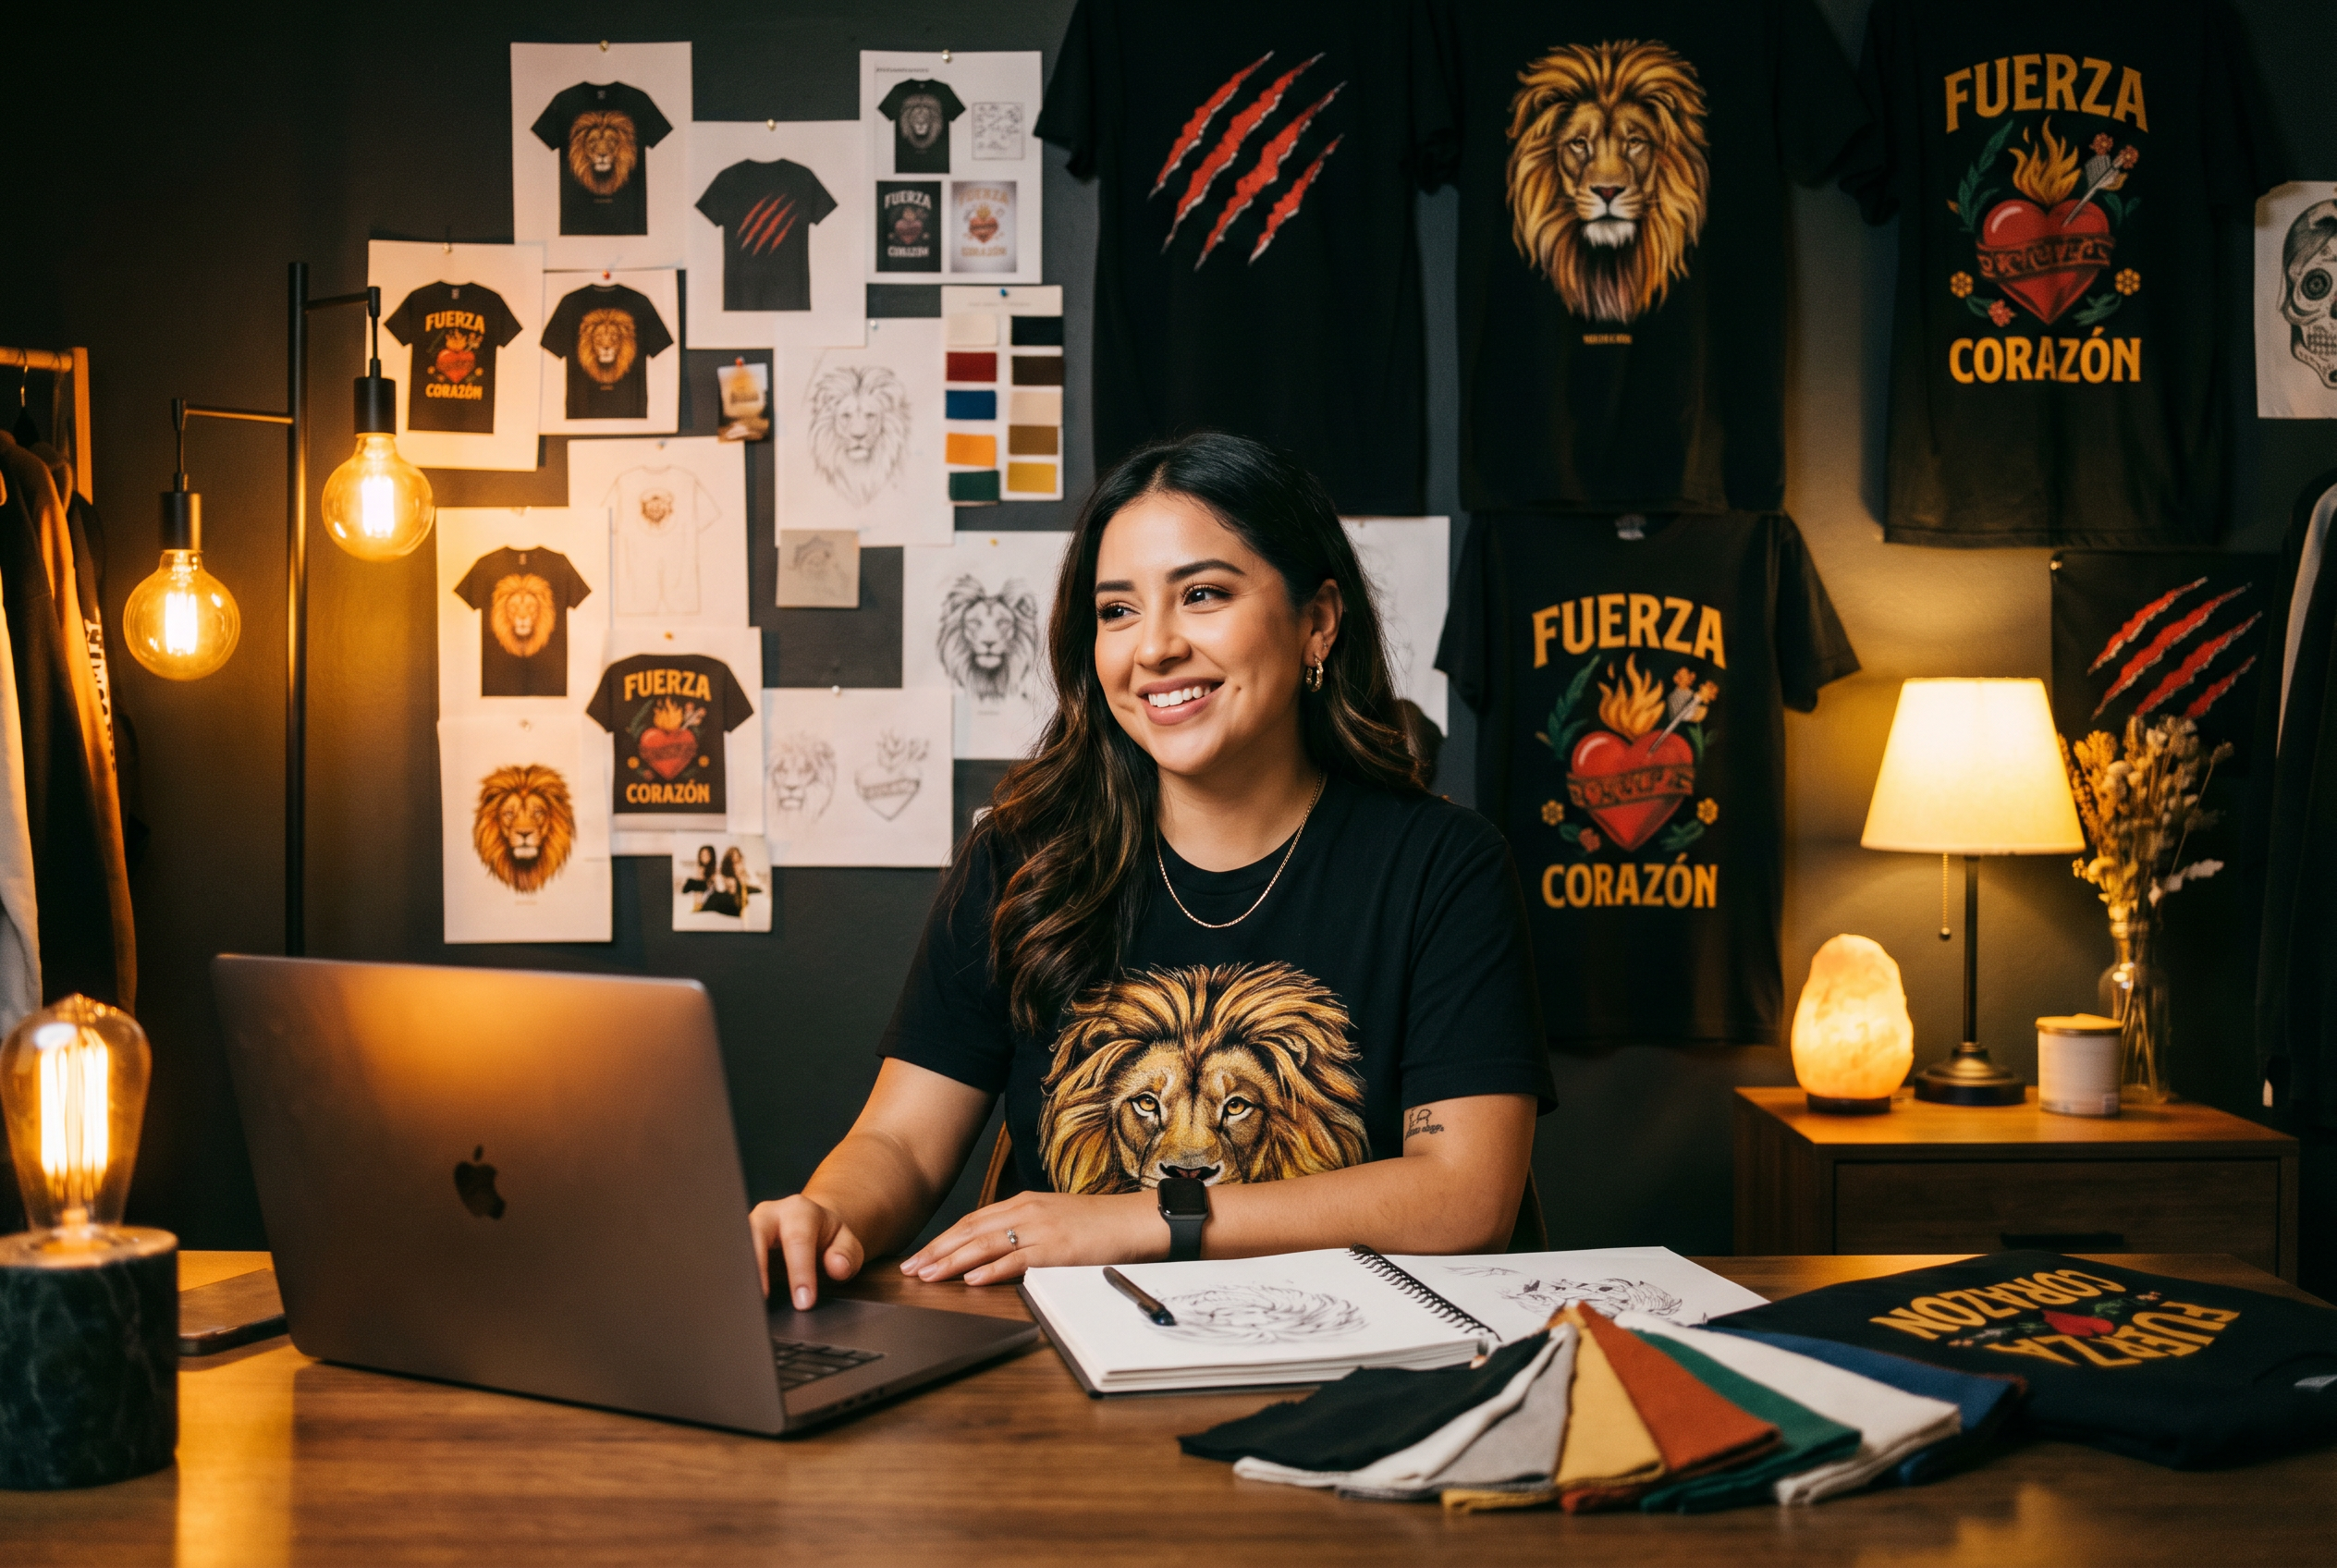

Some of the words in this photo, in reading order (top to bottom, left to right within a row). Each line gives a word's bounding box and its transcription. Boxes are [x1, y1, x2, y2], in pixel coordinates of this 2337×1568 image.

[1944, 53, 2148, 134] FUERZA
[425, 310, 485, 334] FUERZA
[1949, 326, 2142, 384] CORAZÓN
[1532, 593, 1727, 669] FUERZA
[624, 668, 712, 702] FUERZA
[626, 778, 711, 803] CORAZÓN
[1542, 852, 1719, 909] CORAZÓN
[1983, 1301, 2240, 1367] FUERZA
